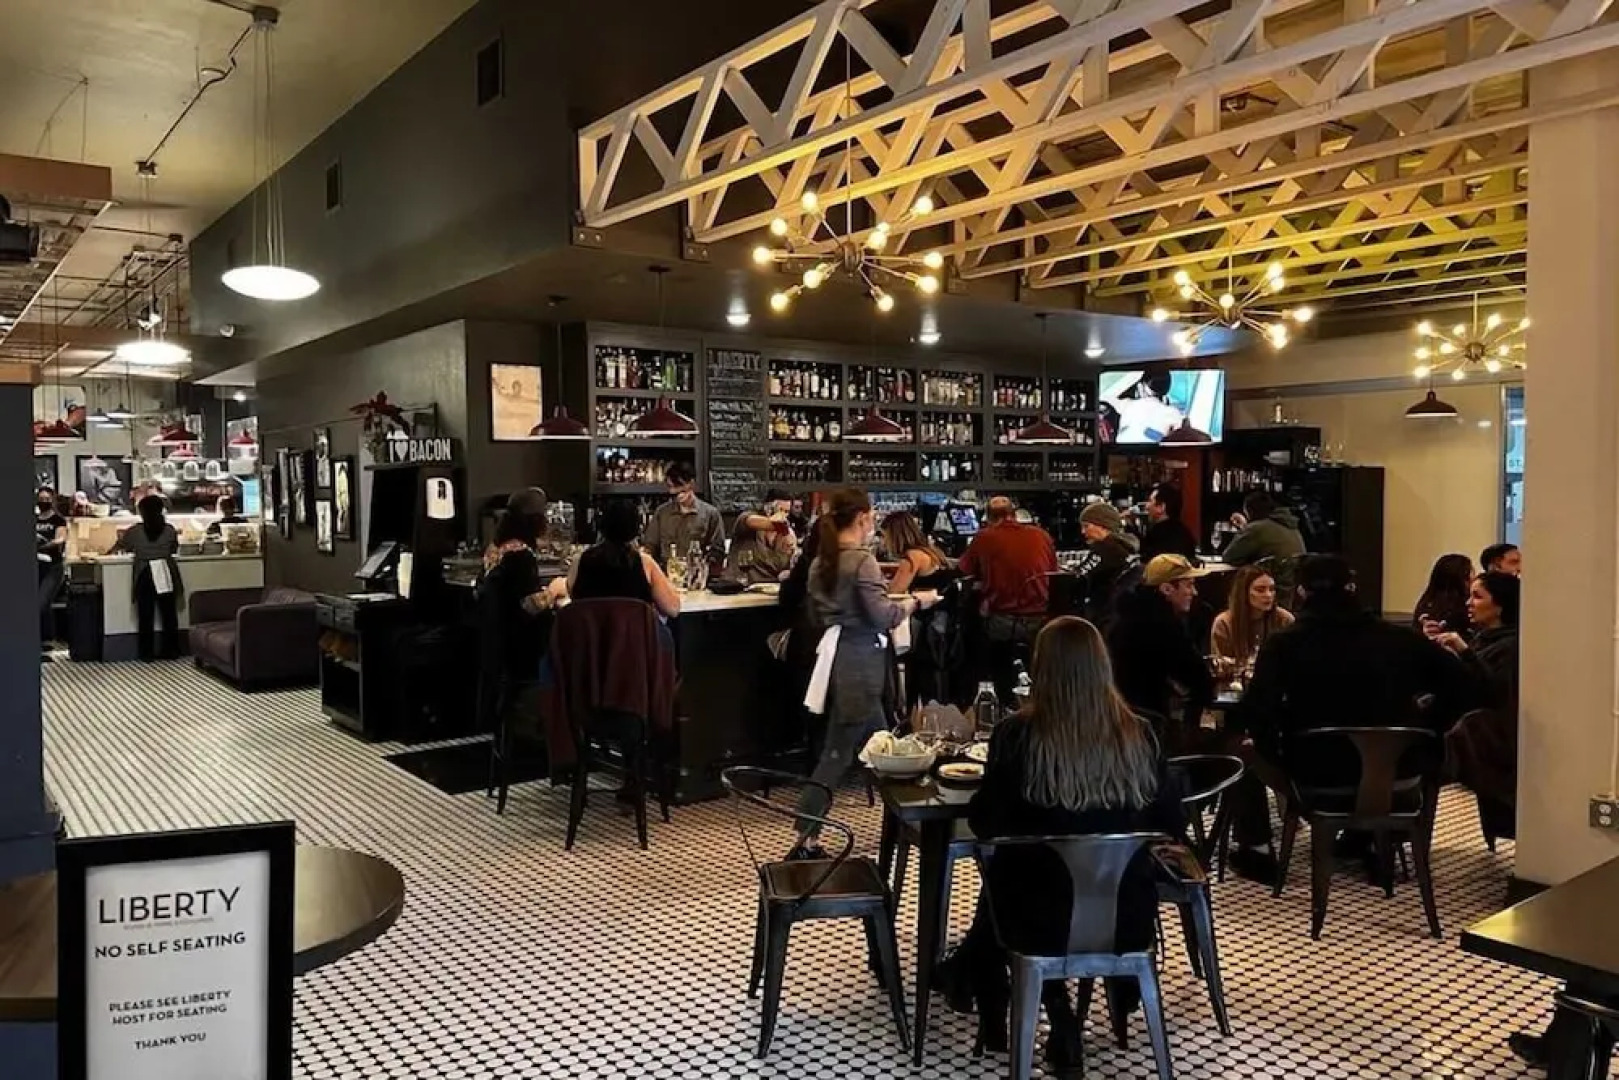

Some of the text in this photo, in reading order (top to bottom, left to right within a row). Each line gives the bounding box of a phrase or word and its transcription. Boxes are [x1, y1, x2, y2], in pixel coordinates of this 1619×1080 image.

[389, 438, 451, 463] I BACON
[99, 886, 240, 924] LIBERTY
[95, 931, 246, 958] NO SELF SEATING
[109, 989, 231, 1012] PLEASE SEE LIBERTY
[112, 1004, 227, 1024] HOST FOR SEATING
[135, 1032, 206, 1049] THANK YOU
